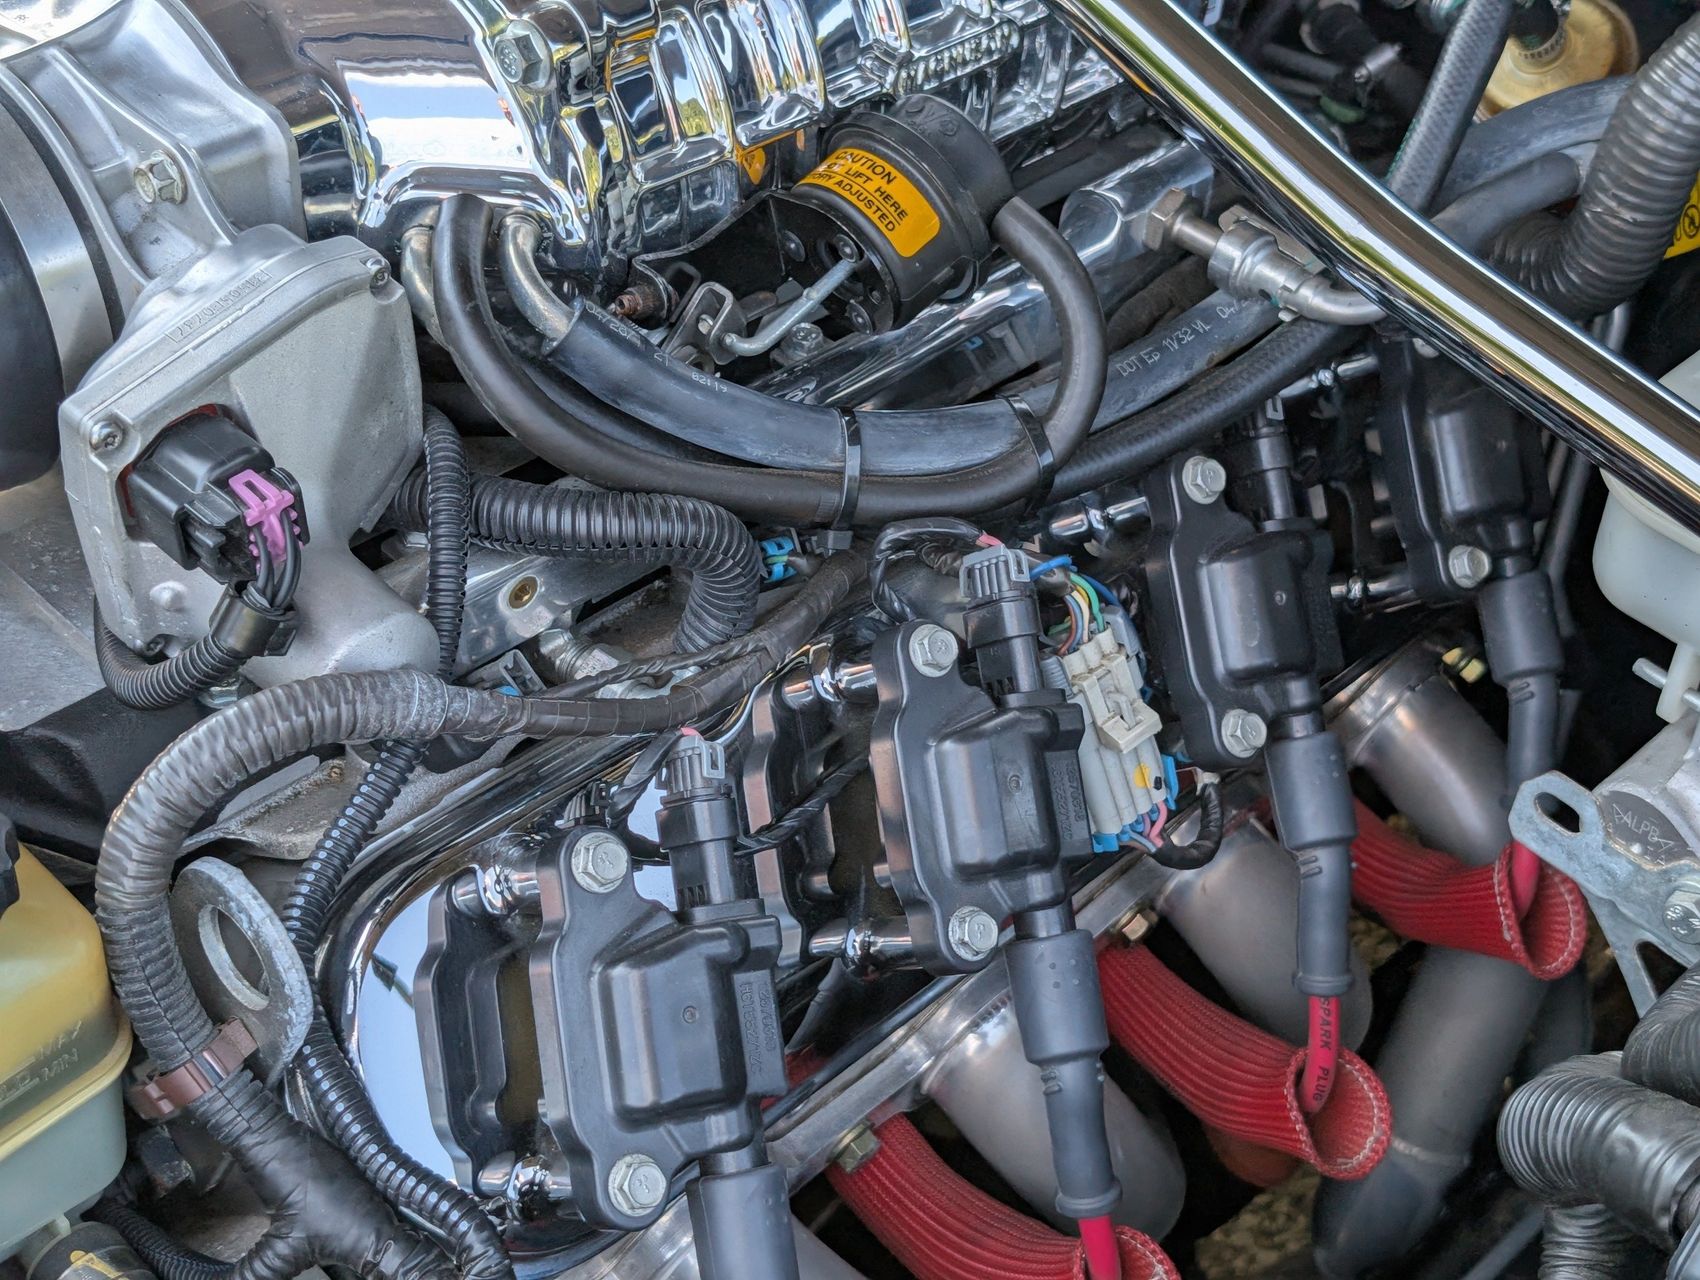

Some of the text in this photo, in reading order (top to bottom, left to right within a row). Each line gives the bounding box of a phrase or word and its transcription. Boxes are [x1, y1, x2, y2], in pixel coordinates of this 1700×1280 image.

[835, 151, 897, 185] CAUTION
[845, 165, 873, 185] LIFT
[874, 185, 909, 222] HERE
[834, 179, 896, 232] ADJUSTED
[1115, 355, 1143, 377] DOT
[1312, 997, 1333, 1102] SPARK PLUG
